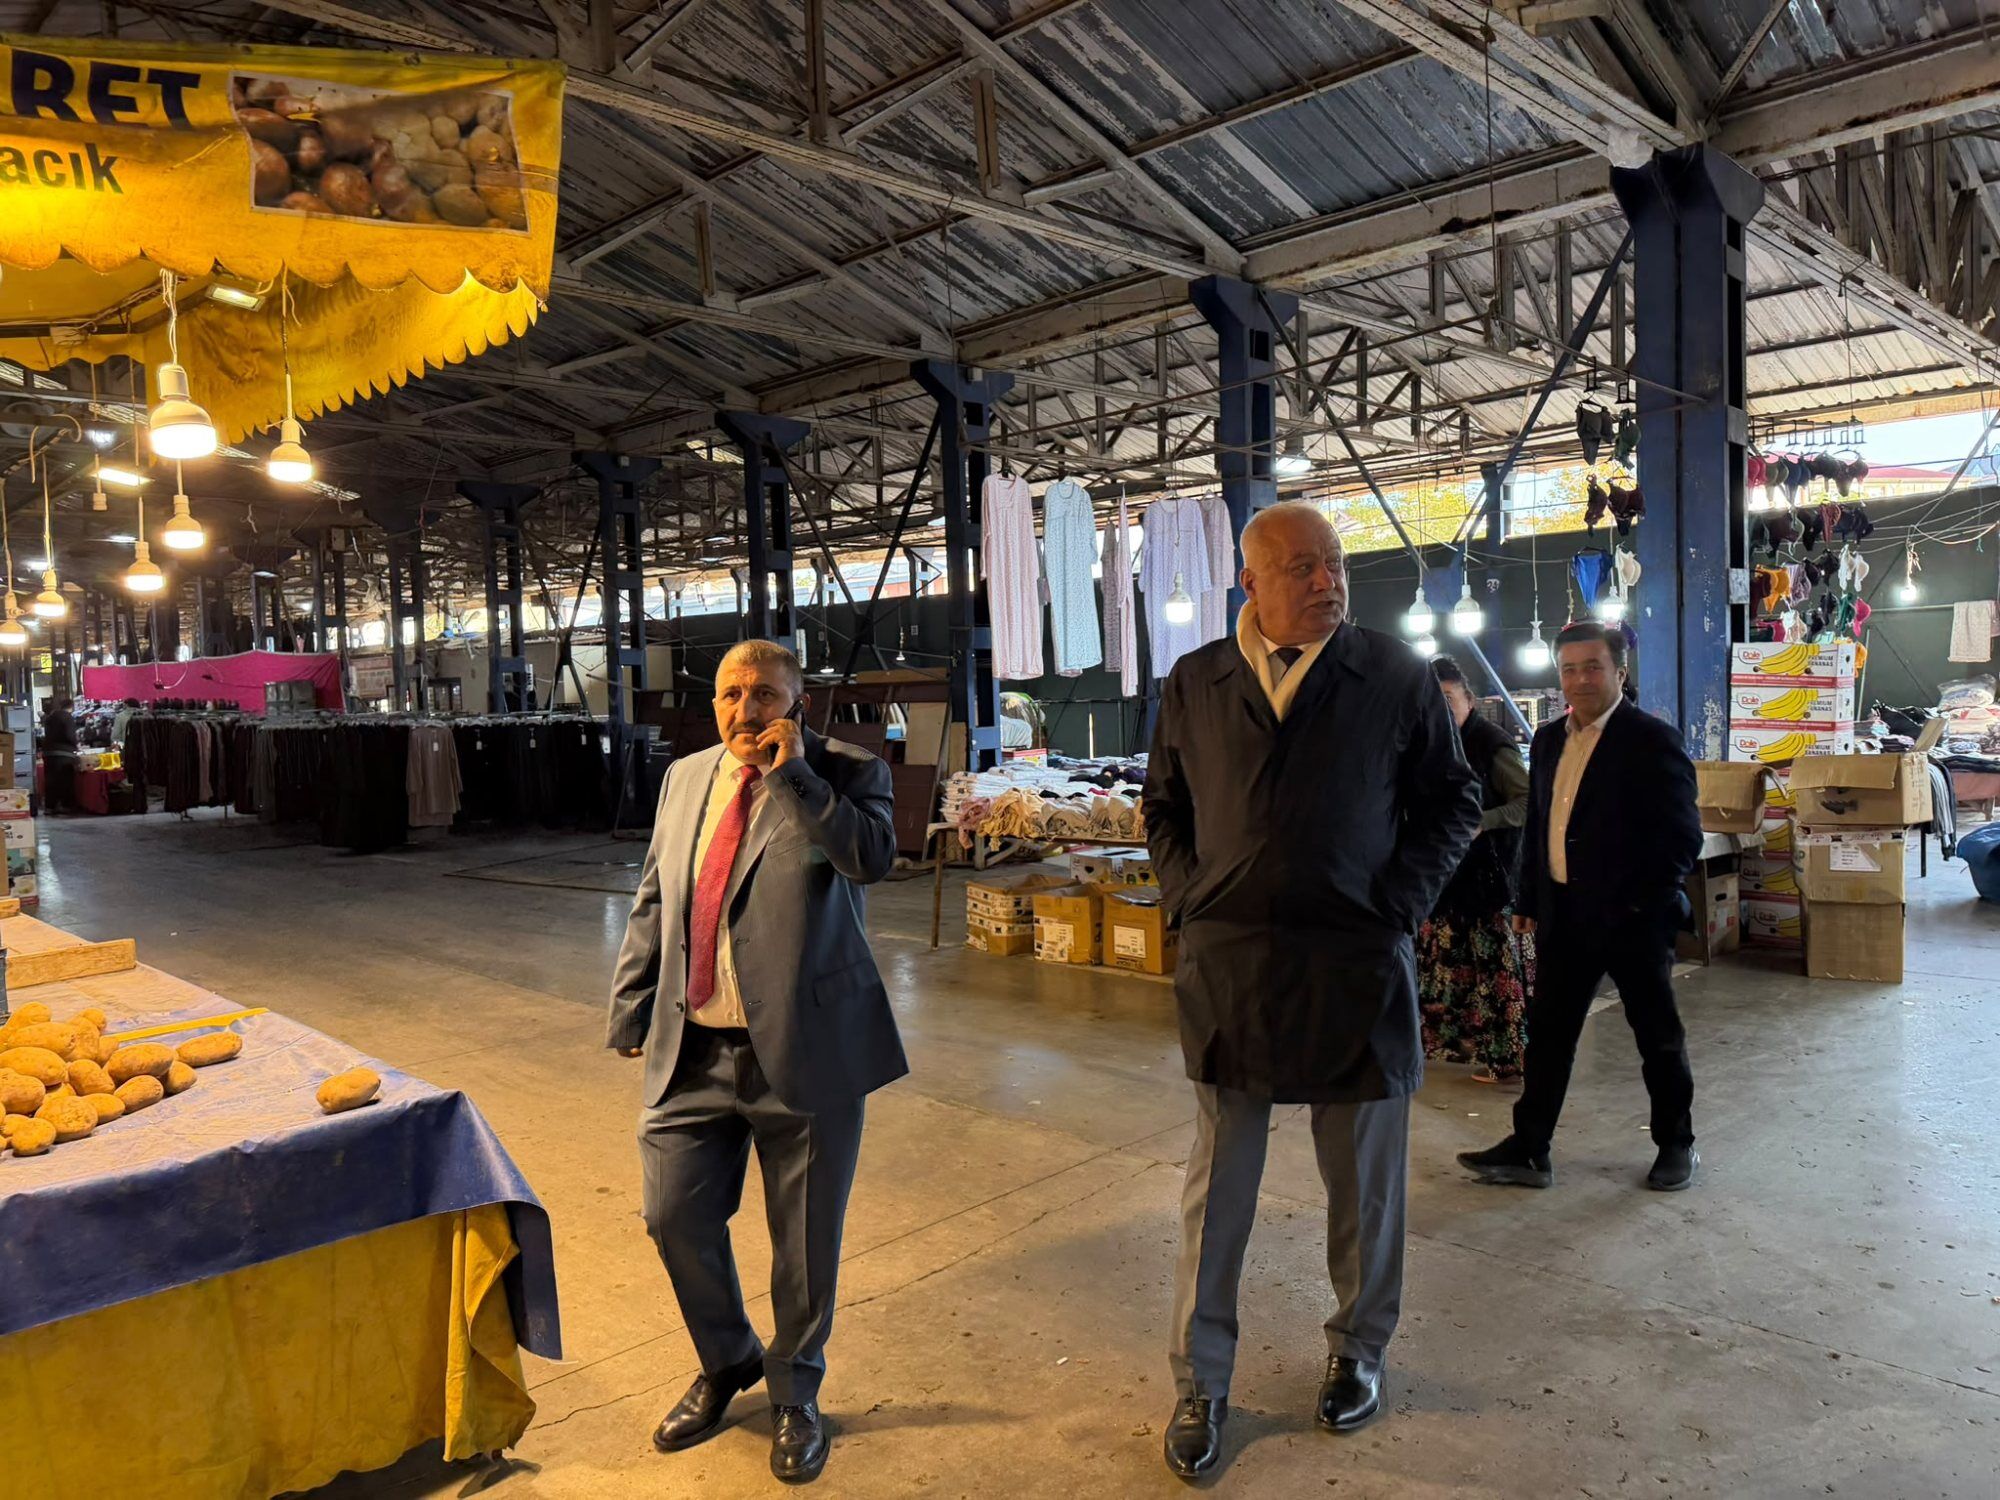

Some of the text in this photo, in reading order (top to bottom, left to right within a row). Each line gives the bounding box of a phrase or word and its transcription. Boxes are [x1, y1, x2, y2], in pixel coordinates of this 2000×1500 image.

[11, 48, 201, 131] RET
[1742, 650, 1760, 659] Dole
[1741, 696, 1759, 704] Dole
[1739, 739, 1757, 748] Dole
